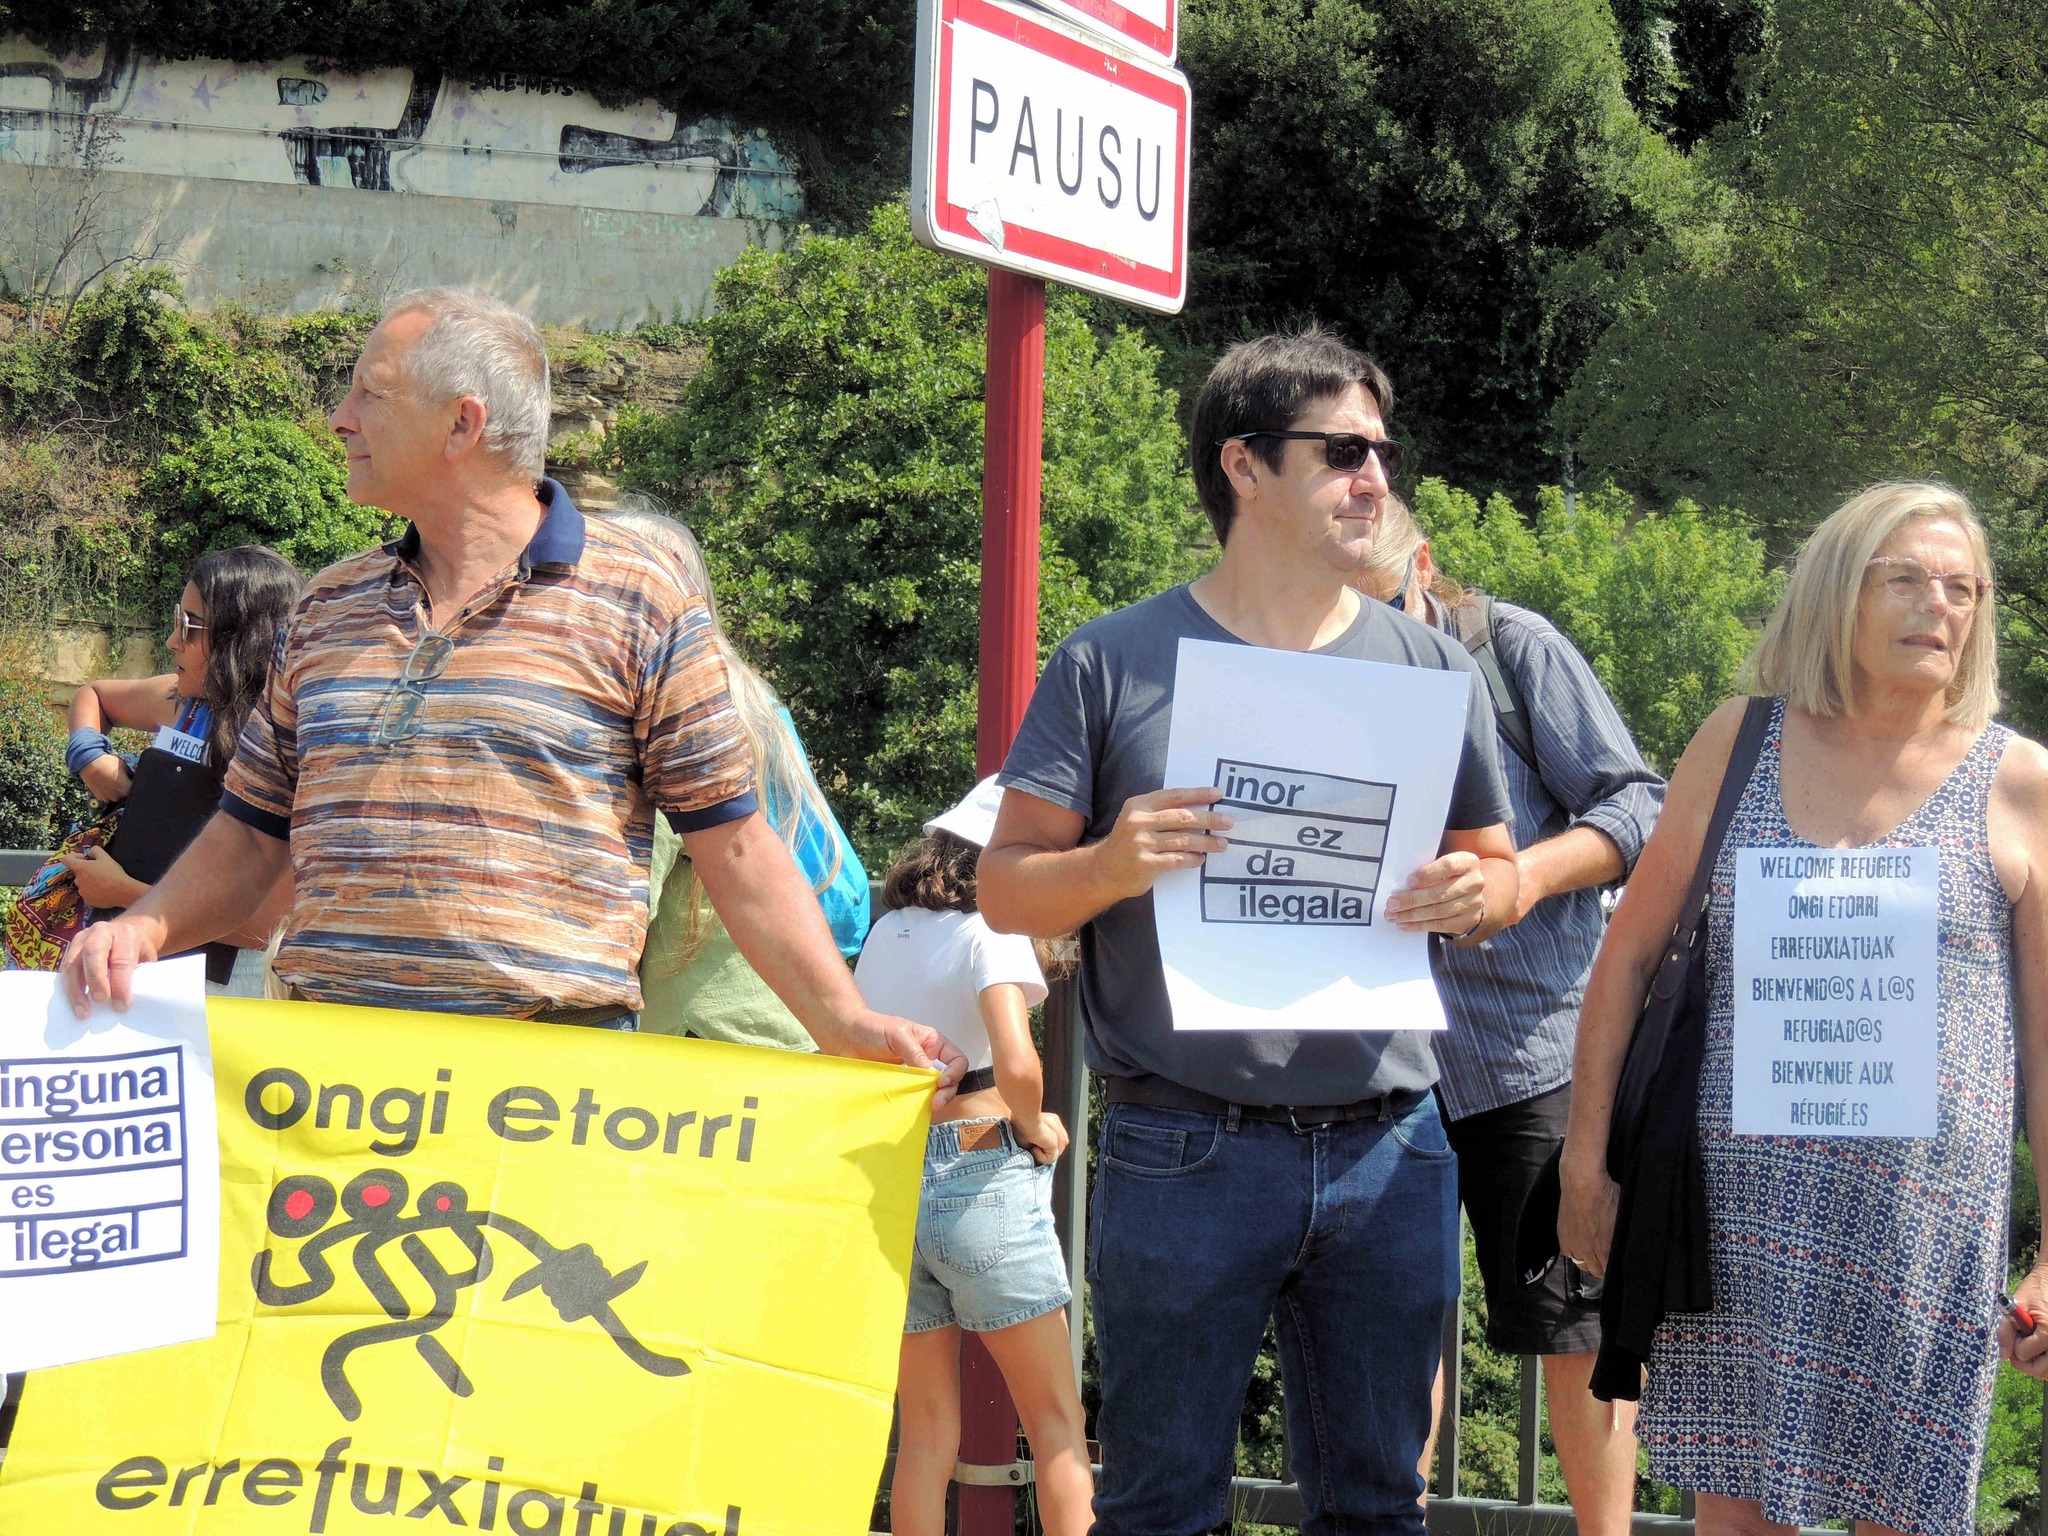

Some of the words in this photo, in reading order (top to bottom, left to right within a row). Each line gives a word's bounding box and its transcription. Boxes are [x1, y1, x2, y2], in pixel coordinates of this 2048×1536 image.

[970, 77, 1161, 222] PAUSU
[1225, 767, 1305, 807] inor
[1297, 826, 1343, 850] ez
[1246, 850, 1295, 877] da
[1760, 856, 1835, 879] WELCOME
[1840, 855, 1911, 878] REFUGEES
[1239, 886, 1362, 922] ilegala
[1788, 896, 1823, 919] ONGI
[1829, 895, 1878, 919] ETORRI
[1771, 936, 1895, 960] ERREFUXIATUAK
[1752, 976, 1855, 1002] BIENVENID@S
[1860, 978, 1872, 1001] A
[1879, 976, 1915, 1002] L@S
[1784, 1017, 1882, 1043] REFUGIAD@S
[1772, 1060, 1853, 1085] BIENVENUE
[1859, 1061, 1894, 1085] AUX
[244, 1067, 452, 1157] ongi
[487, 1085, 758, 1162] etorri
[1791, 1098, 1868, 1127] RÉFUGIÉ.ES
[1, 1120, 172, 1164] ersona
[11, 1184, 55, 1208] es
[15, 1211, 139, 1267] ilegal
